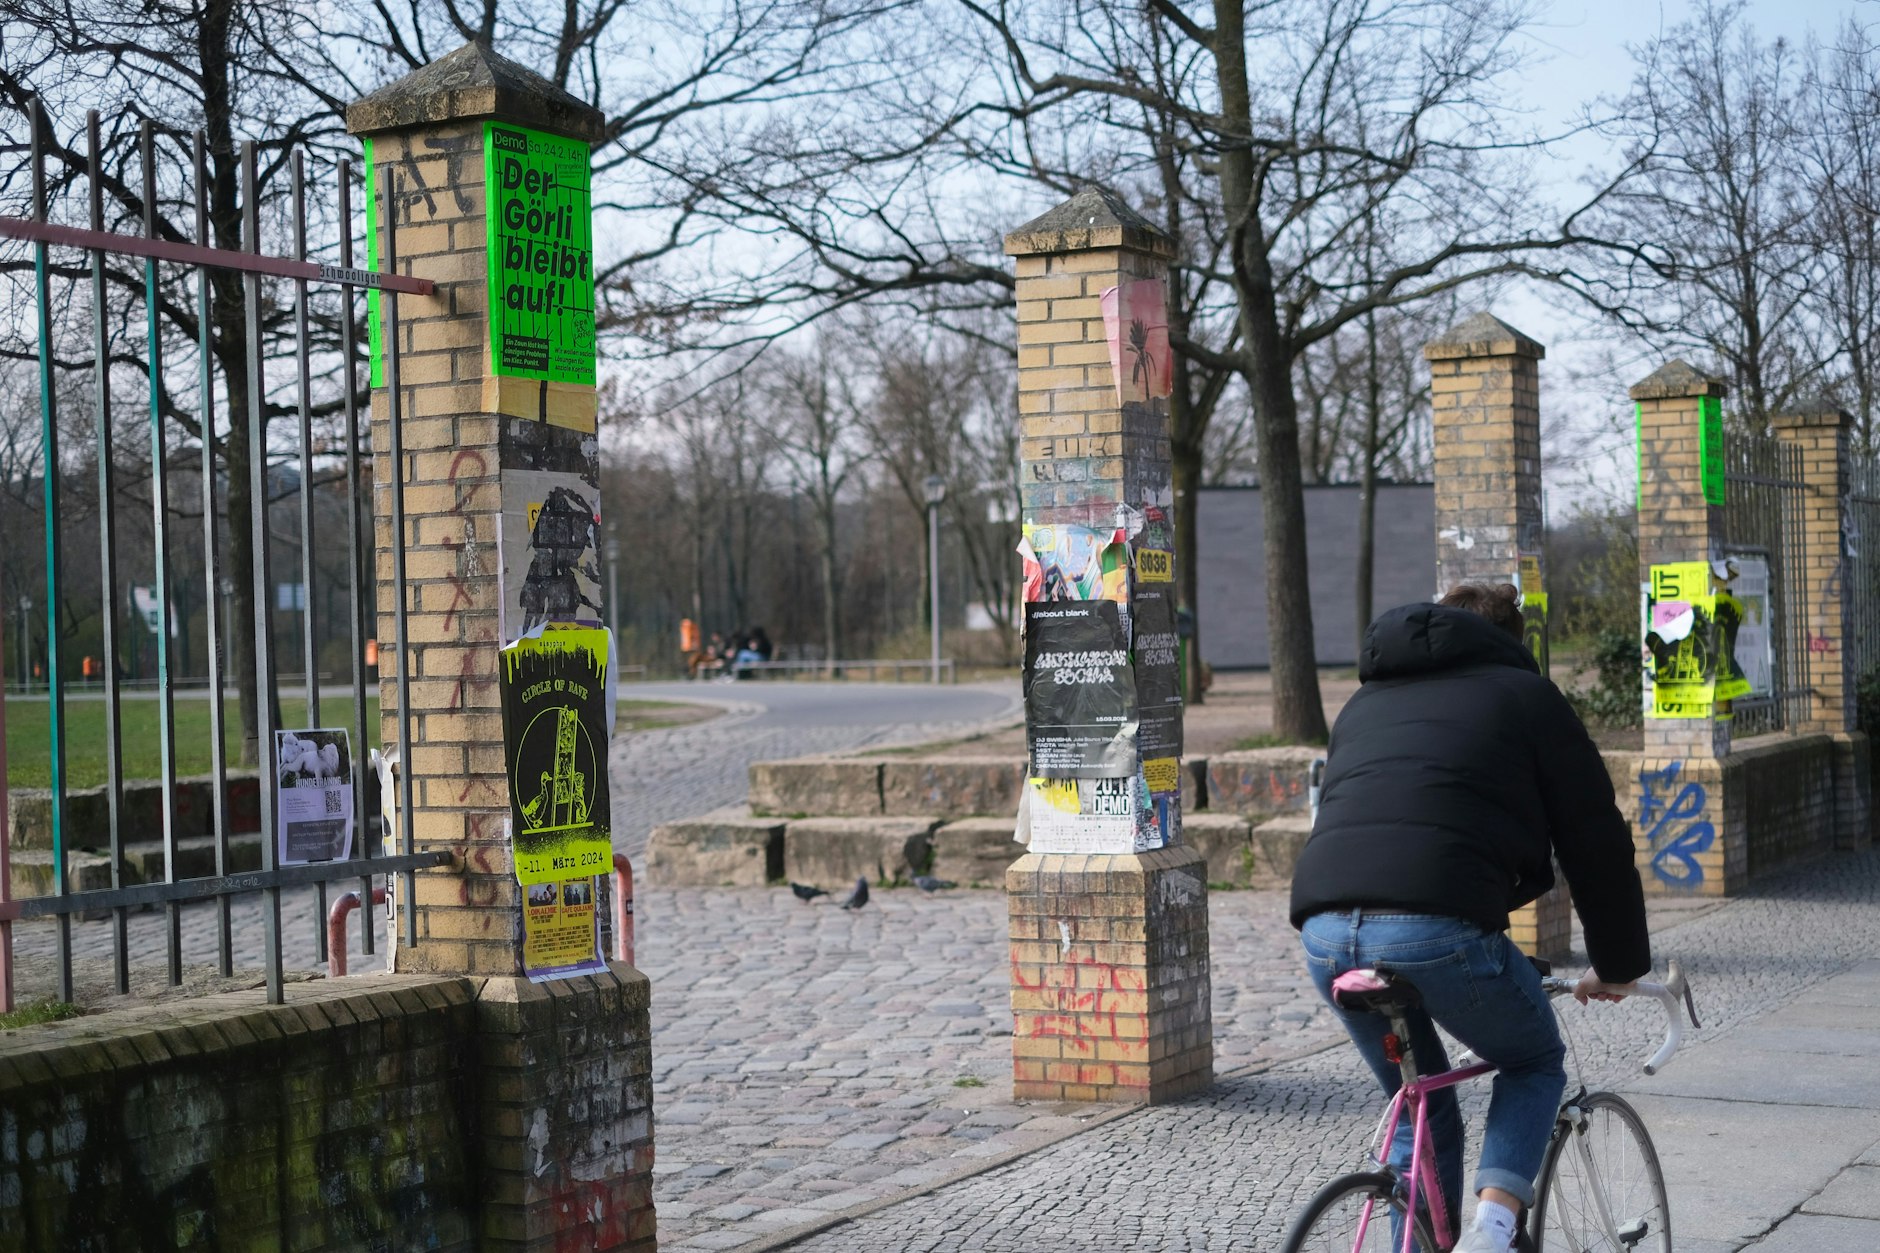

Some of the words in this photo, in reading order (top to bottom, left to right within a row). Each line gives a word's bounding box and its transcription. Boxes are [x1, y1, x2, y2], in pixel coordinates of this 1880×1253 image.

[494, 132, 526, 150] Demo
[568, 147, 583, 163] 14h
[503, 157, 554, 196] Der
[504, 198, 573, 240] Görli
[505, 236, 589, 282] bleibt
[319, 264, 381, 286] Schwooligan
[506, 280, 566, 317] auf!
[505, 338, 514, 346] Ein
[527, 341, 537, 349] löst
[525, 350, 547, 359] Problem
[1065, 609, 1090, 617] blank
[521, 680, 552, 704] CIRCLE
[554, 679, 566, 692] OF
[568, 680, 589, 701] RAVE
[1093, 795, 1131, 815] DEMO
[552, 856, 576, 870] März
[581, 851, 604, 866] 2024
